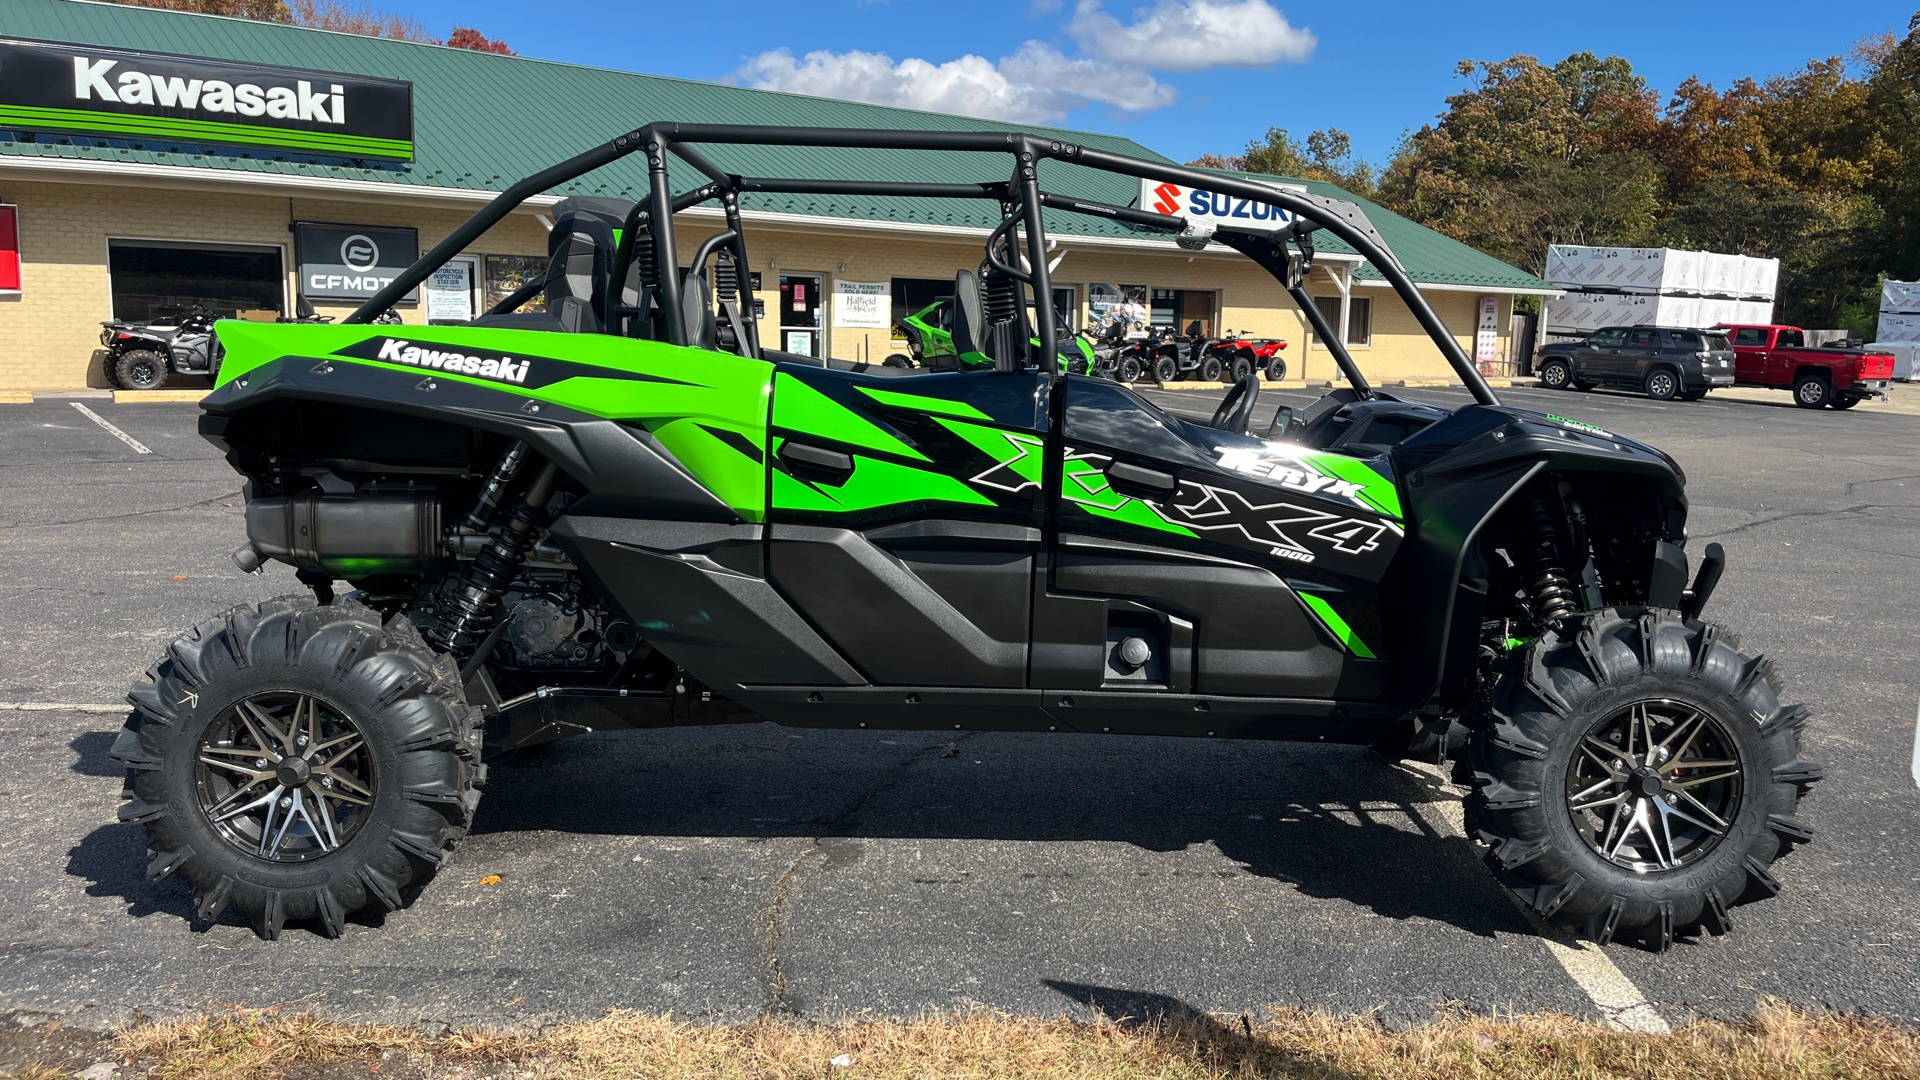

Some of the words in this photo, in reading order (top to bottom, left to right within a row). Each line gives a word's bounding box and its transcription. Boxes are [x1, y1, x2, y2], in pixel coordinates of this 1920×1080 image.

[73, 56, 346, 125] Kawasaki
[310, 273, 396, 291] CFMOT
[846, 295, 877, 307] Hatfield
[378, 338, 531, 383] Kawasaki
[1213, 446, 1371, 499] TERYX
[1269, 546, 1316, 563] 1000
